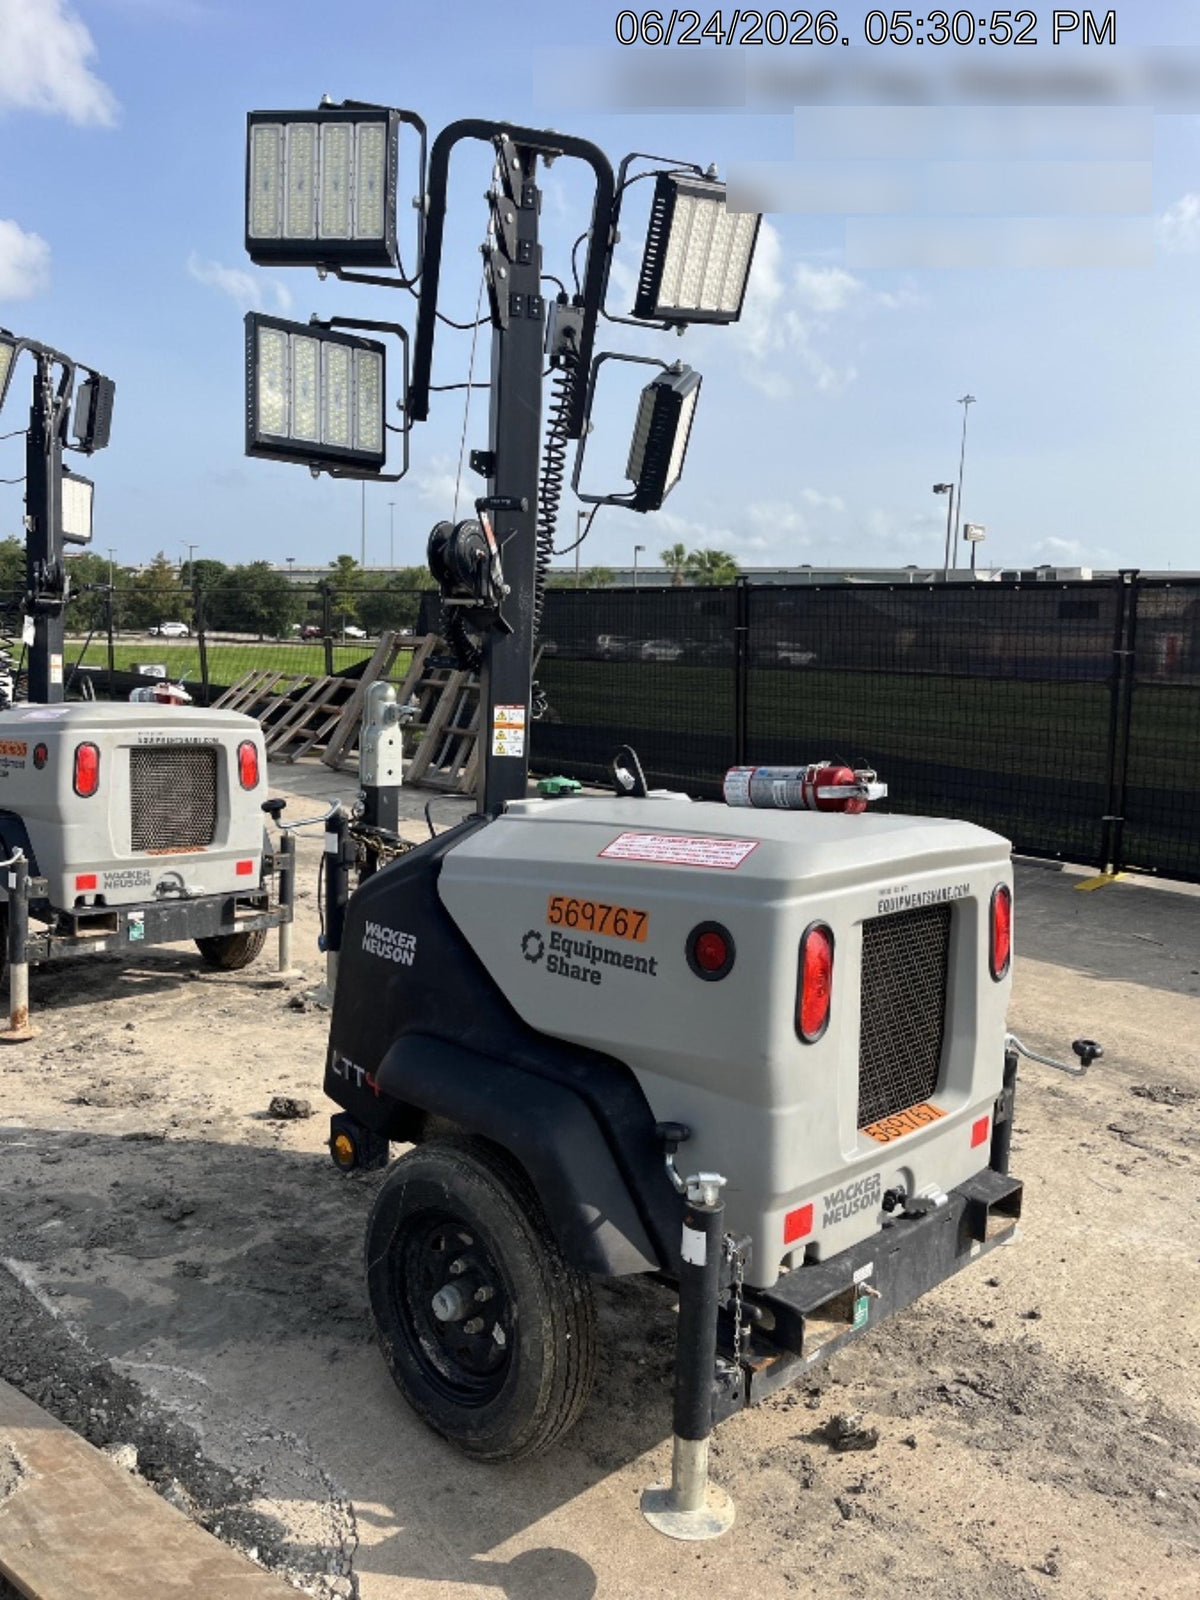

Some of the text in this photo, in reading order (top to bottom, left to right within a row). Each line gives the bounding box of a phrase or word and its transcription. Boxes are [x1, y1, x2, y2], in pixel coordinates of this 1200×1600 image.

[103, 870, 151, 881] WACKER
[365, 920, 417, 951] WACKER
[549, 897, 647, 939] 569767
[361, 935, 415, 966] NEUSON
[546, 954, 602, 986] Share
[549, 931, 658, 976] Equipment
[863, 1103, 942, 1142] 569767
[822, 1187, 881, 1229] NEUSON
[823, 1172, 881, 1211] WACKER
